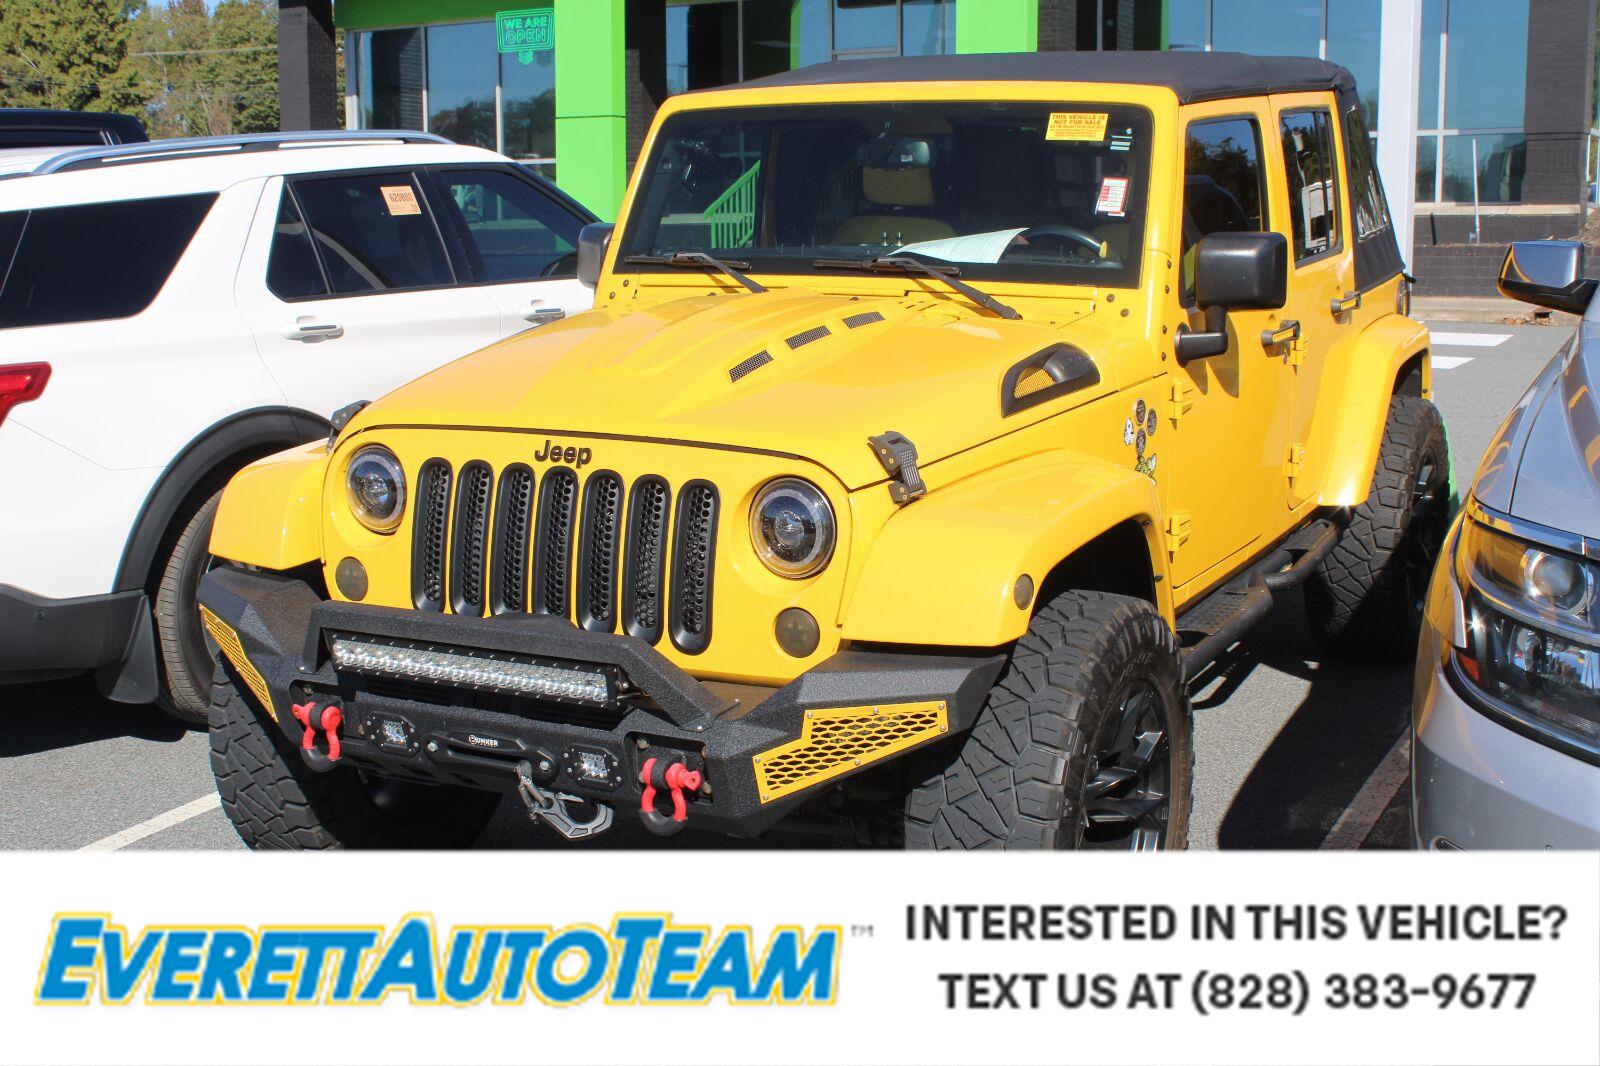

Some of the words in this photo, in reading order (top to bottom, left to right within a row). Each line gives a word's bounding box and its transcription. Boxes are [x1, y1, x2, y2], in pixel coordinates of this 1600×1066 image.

[504, 19, 522, 29] WE
[525, 16, 547, 28] ARE
[505, 28, 546, 44] OPEN
[534, 439, 593, 469] Jeep
